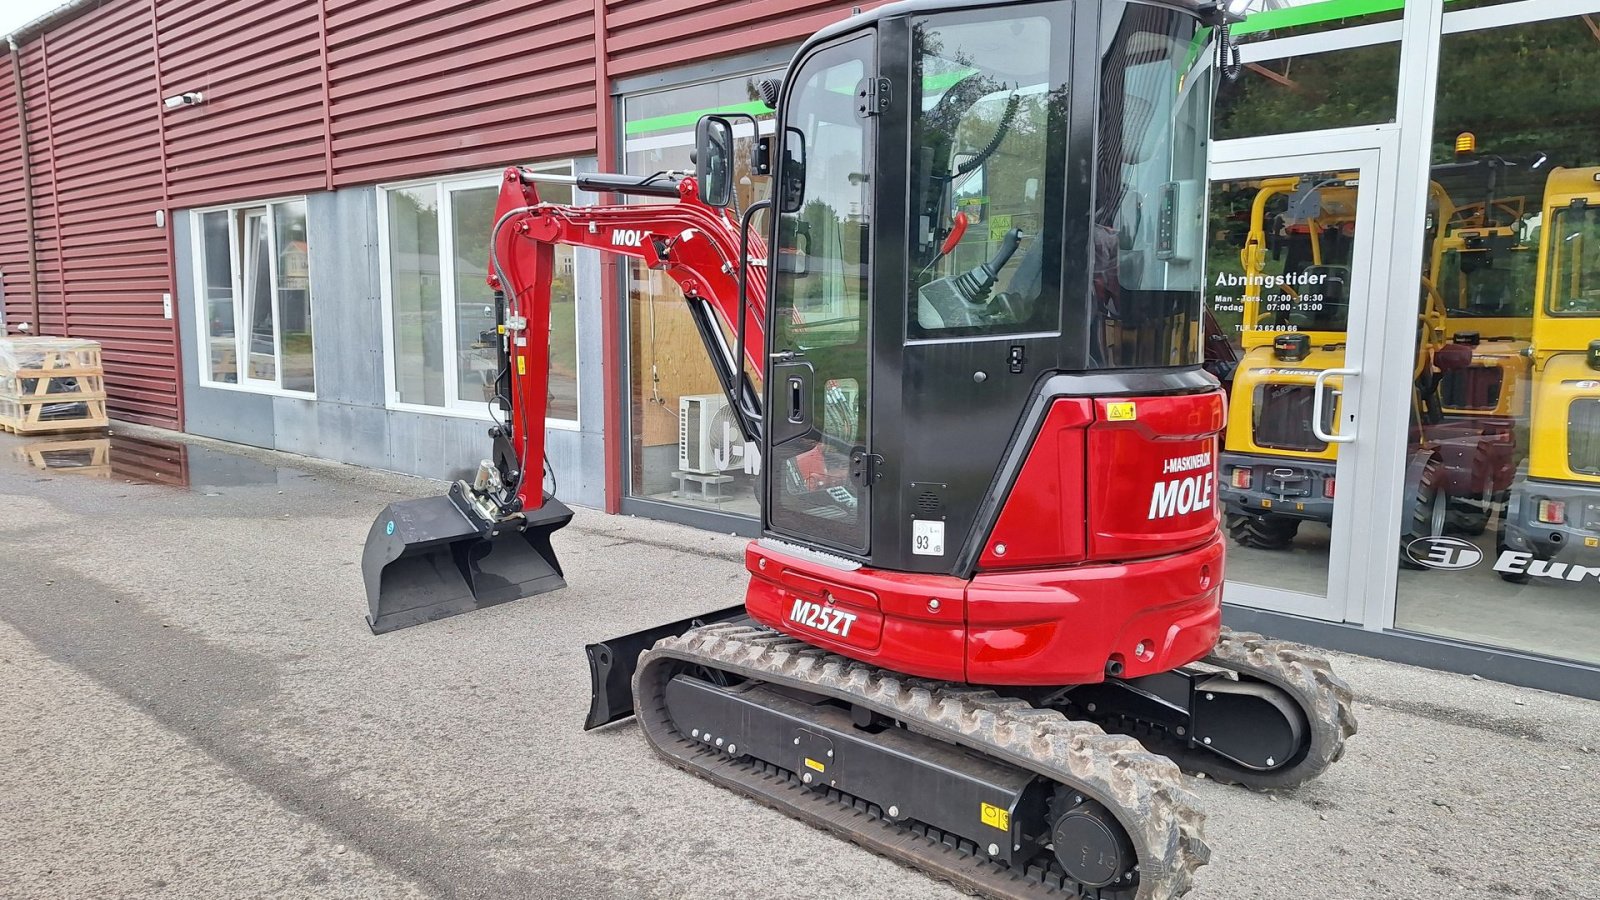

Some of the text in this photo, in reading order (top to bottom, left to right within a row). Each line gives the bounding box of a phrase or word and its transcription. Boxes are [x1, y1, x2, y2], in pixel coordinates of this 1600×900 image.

[612, 229, 653, 247] MOL
[1215, 272, 1327, 288] Åbningstider
[1215, 295, 1232, 303] Man
[1267, 294, 1291, 302] 07:00
[1299, 294, 1323, 302] 16:30
[1215, 303, 1244, 312] Fredag
[1266, 303, 1291, 311] 07:00
[1299, 303, 1323, 311] 13:00
[1148, 472, 1213, 520] MOLE
[916, 535, 929, 550] 93
[1493, 550, 1600, 582] Eur
[790, 598, 857, 638] M25ZT
